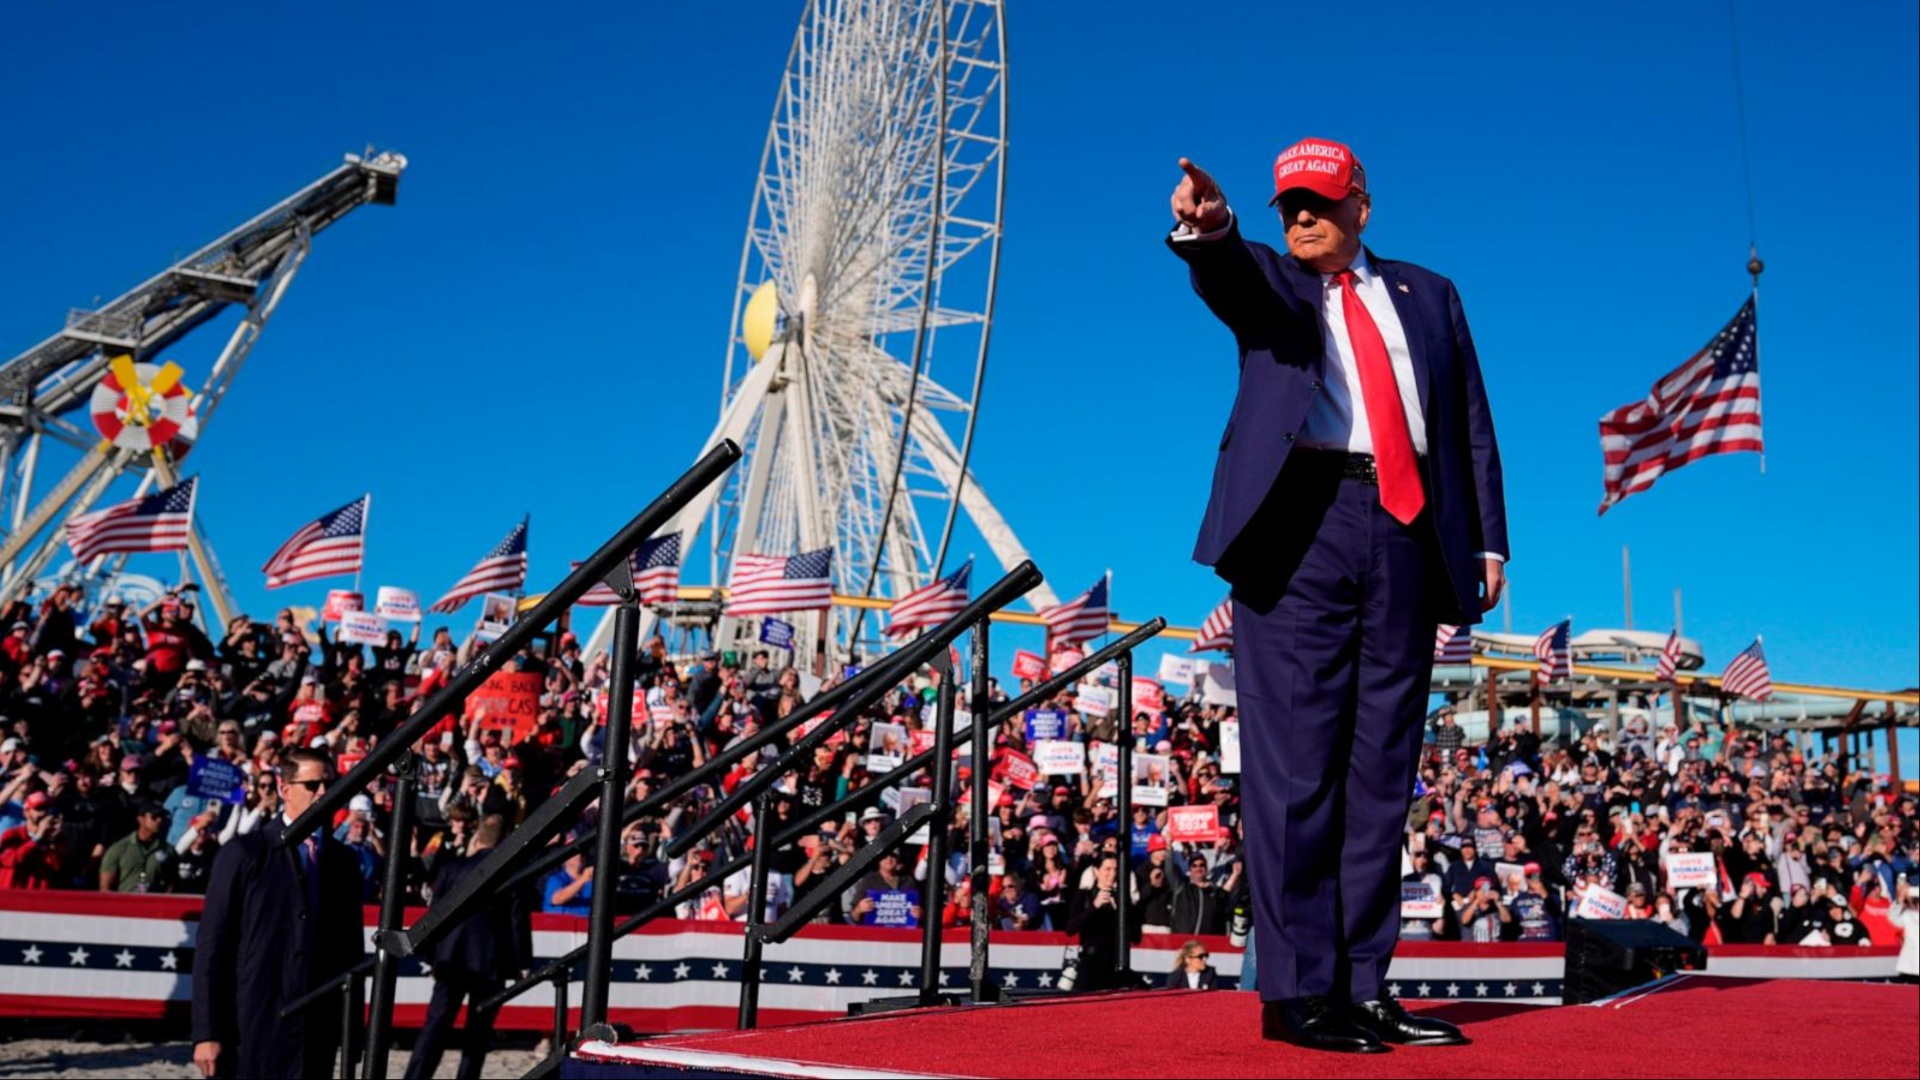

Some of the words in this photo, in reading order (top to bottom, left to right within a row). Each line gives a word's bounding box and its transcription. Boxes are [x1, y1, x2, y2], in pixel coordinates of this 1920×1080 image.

[1278, 146, 1299, 164] MAKE
[1299, 144, 1345, 161] AMERICA
[1279, 160, 1306, 179] GREAT
[1305, 160, 1339, 175] AGAIN
[1173, 813, 1213, 823] TRUMP
[1178, 820, 1209, 831] 2024
[1404, 887, 1430, 895] VOTE
[877, 908, 907, 917] GREAT
